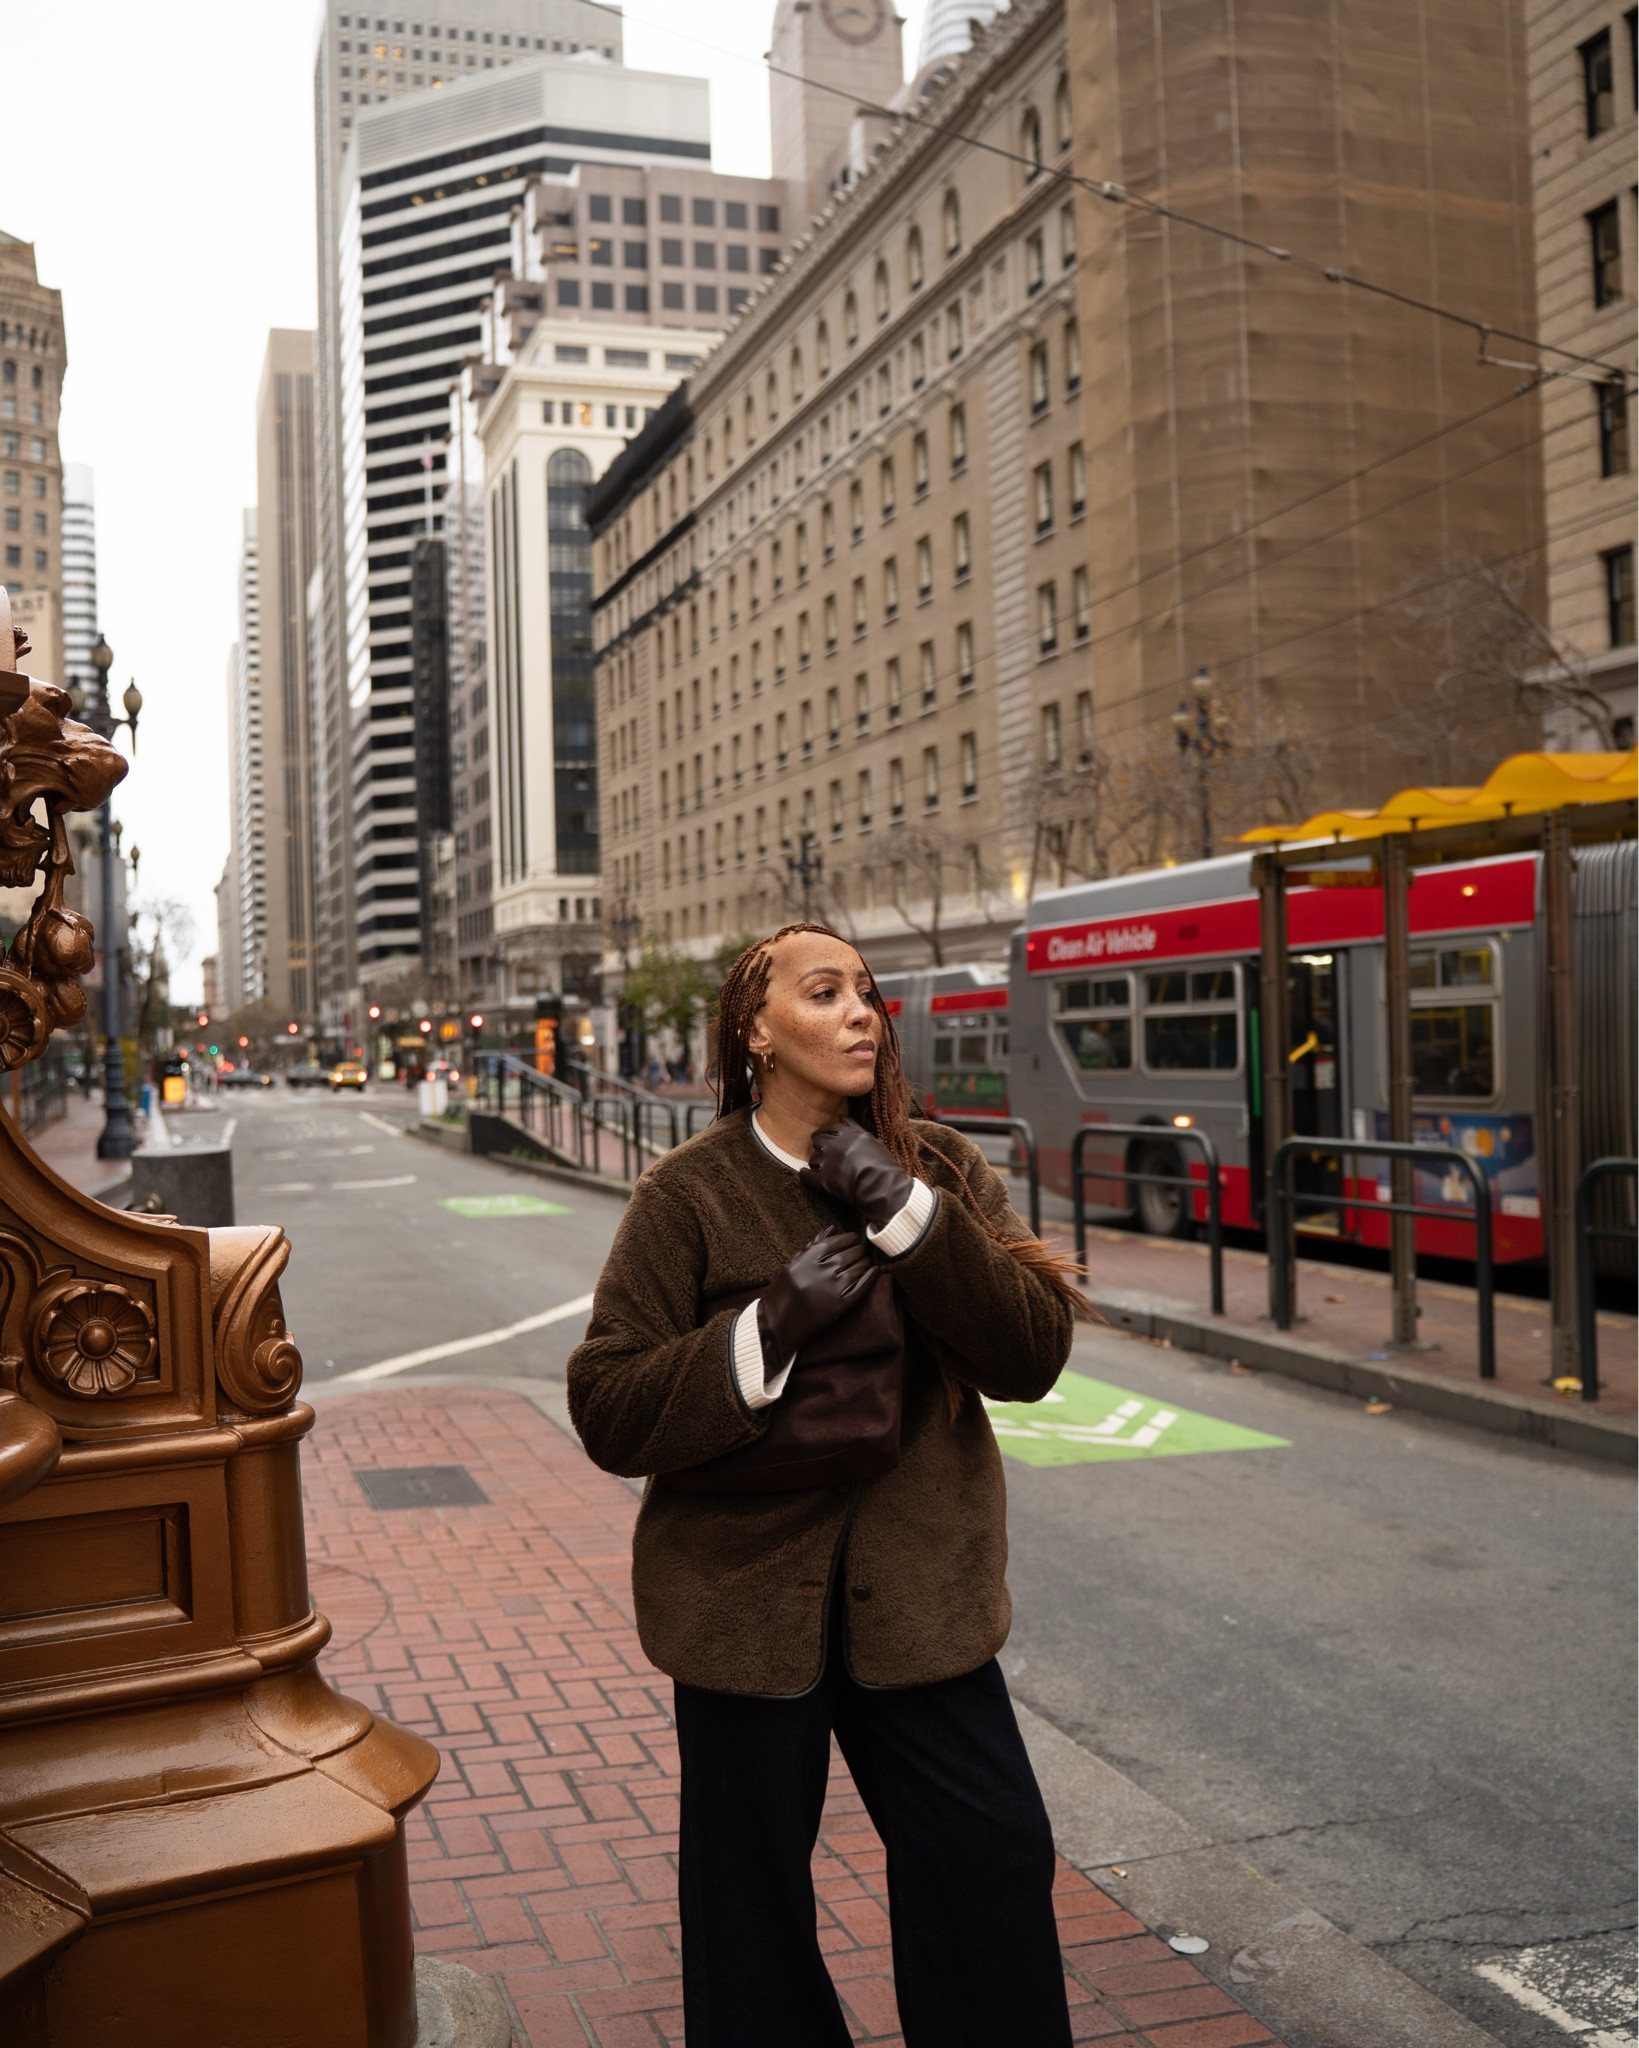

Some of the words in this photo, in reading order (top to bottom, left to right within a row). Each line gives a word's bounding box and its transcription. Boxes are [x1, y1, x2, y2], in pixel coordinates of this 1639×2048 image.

[1047, 936, 1084, 962] Clean
[1085, 931, 1105, 957] Air
[1105, 924, 1157, 954] Vehicle
